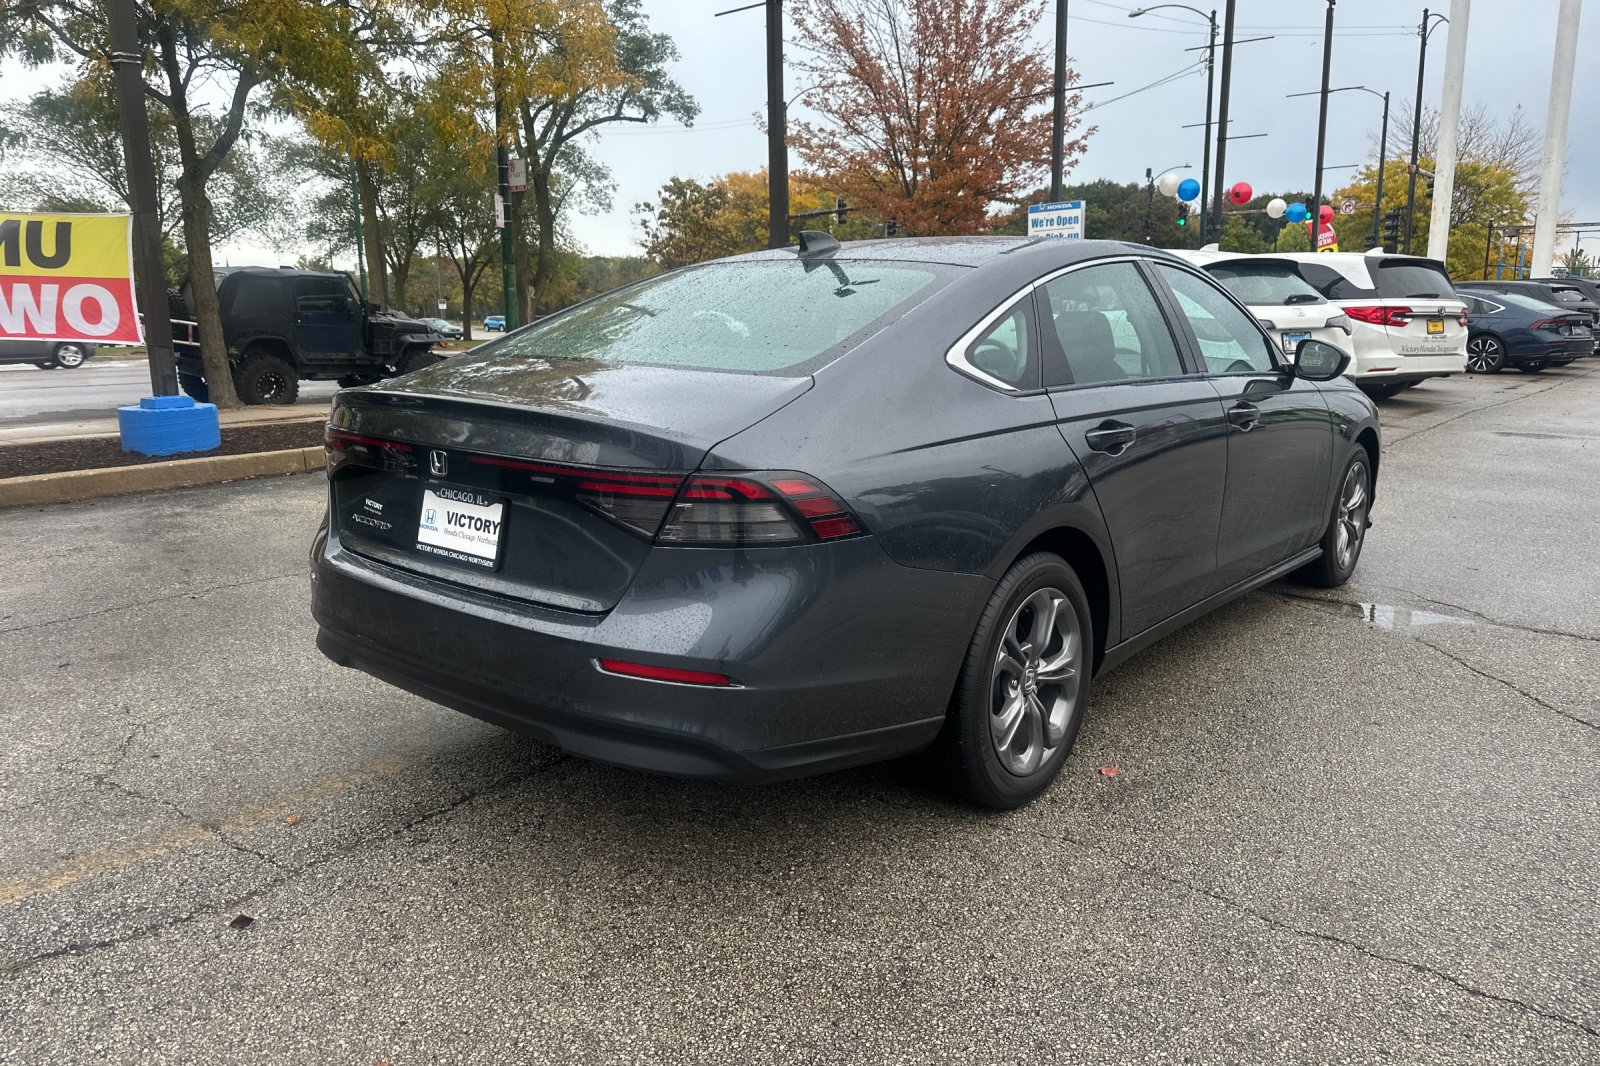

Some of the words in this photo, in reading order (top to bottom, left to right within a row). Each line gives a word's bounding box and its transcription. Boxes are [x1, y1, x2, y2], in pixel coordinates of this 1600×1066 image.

[1031, 217, 1055, 228] We're
[1056, 216, 1079, 226] Open
[440, 488, 475, 504] CHICAGO,
[476, 494, 484, 505] IL
[352, 514, 391, 529] ACCORD
[447, 511, 500, 535] VICTORY
[444, 528, 458, 538] Honda
[458, 532, 476, 543] Chicago
[416, 543, 433, 552] VICTORY
[433, 547, 448, 556] HONDA
[449, 551, 467, 561] CHICAGO
[469, 556, 494, 567] NORTHSIDE
